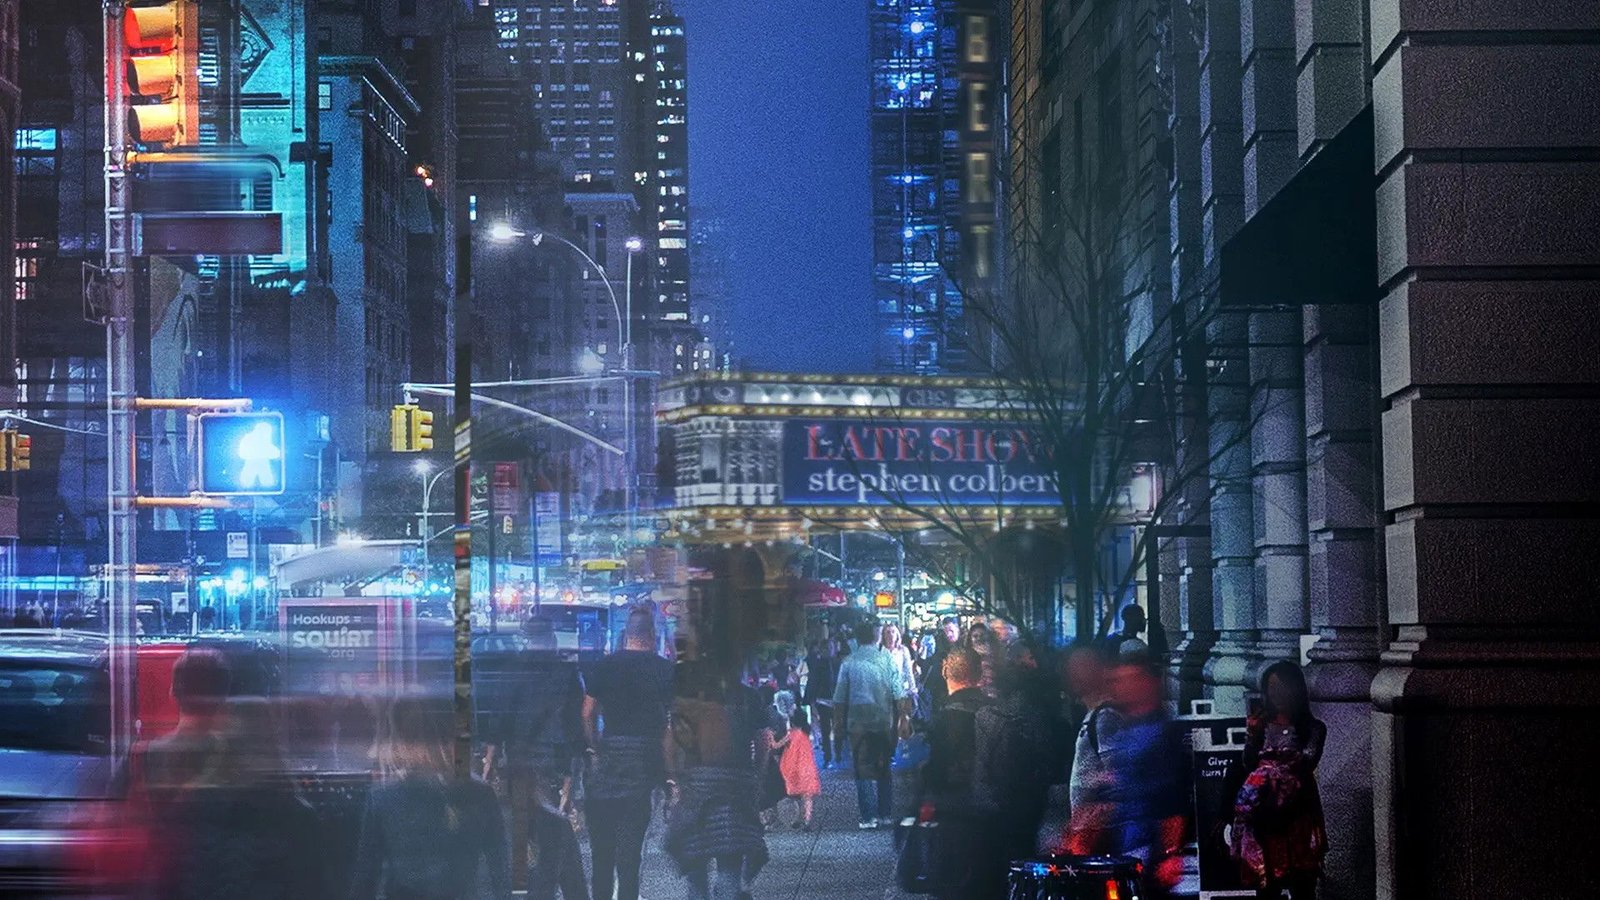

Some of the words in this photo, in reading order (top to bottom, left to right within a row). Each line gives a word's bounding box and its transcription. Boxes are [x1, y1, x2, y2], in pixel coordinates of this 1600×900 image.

[803, 424, 922, 461] LATE
[808, 463, 941, 503] stephen
[293, 613, 350, 626] Hookups
